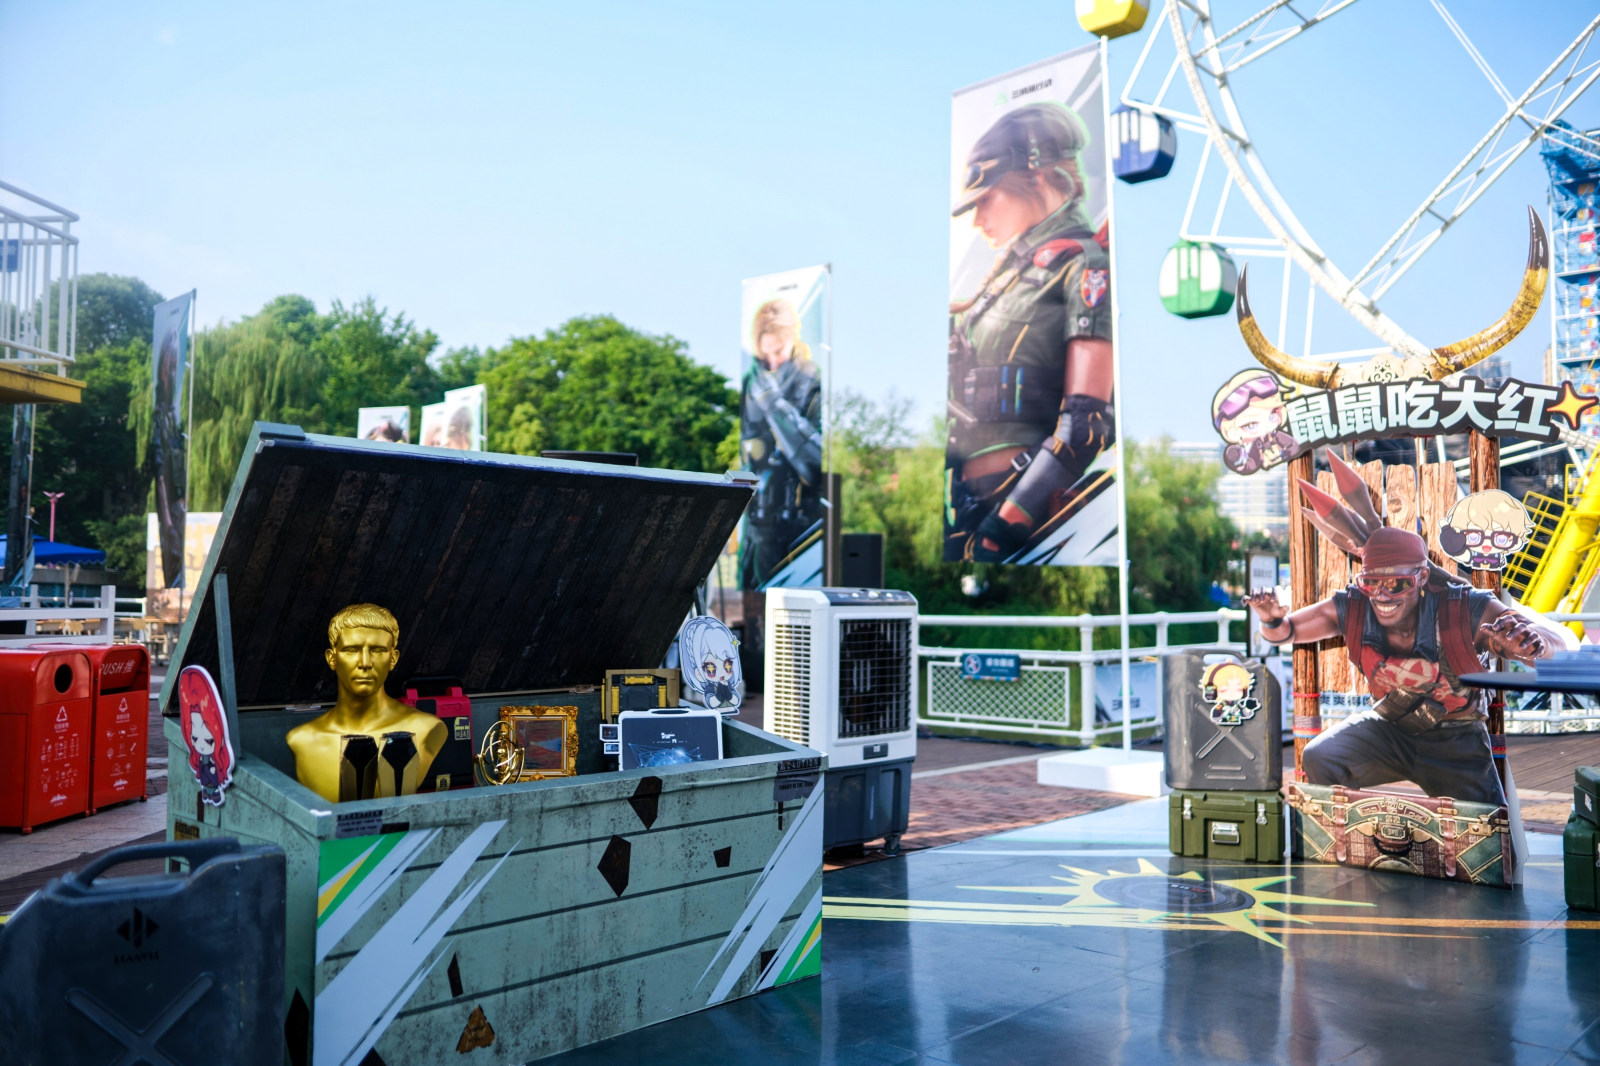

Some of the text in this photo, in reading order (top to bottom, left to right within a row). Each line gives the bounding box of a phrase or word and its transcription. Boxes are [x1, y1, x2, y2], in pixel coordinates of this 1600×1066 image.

[1288, 379, 1559, 445] 鼠鼠吃大红
